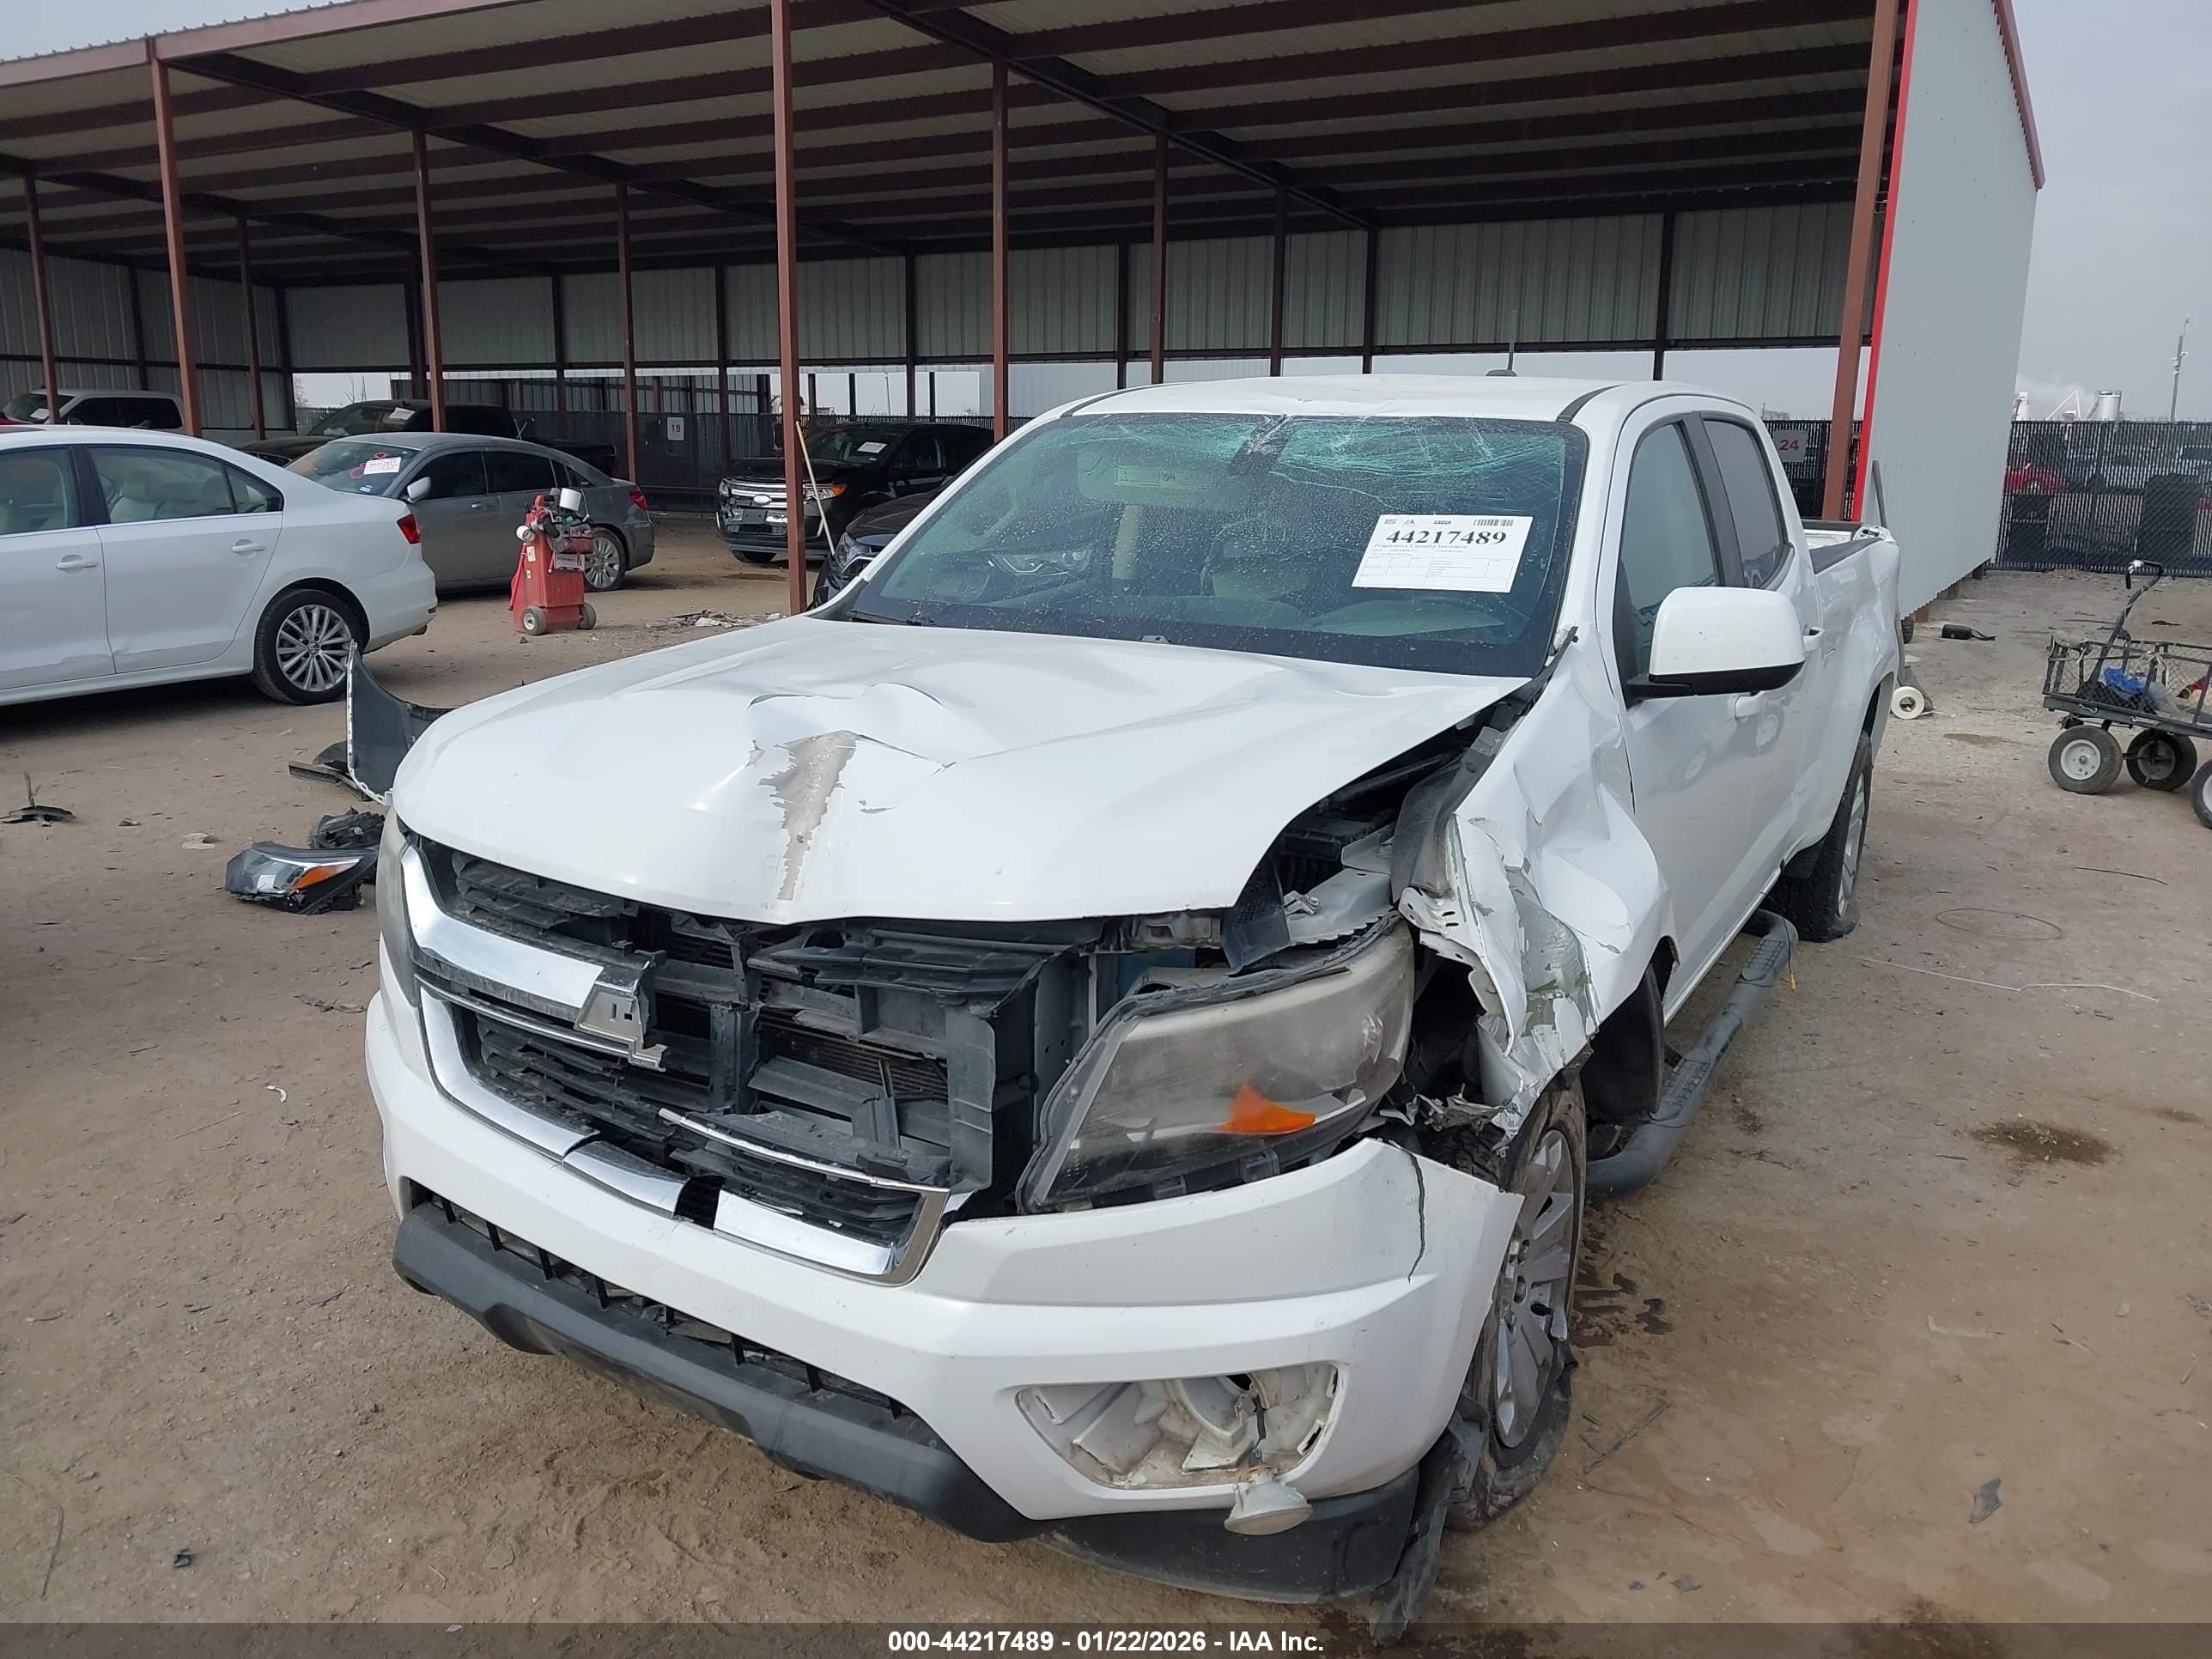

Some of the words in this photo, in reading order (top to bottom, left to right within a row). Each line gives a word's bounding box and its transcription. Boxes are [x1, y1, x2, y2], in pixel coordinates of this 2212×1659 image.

[672, 424, 681, 433] 19
[1779, 439, 1800, 451] 24
[1386, 530, 1507, 545] 44217489
